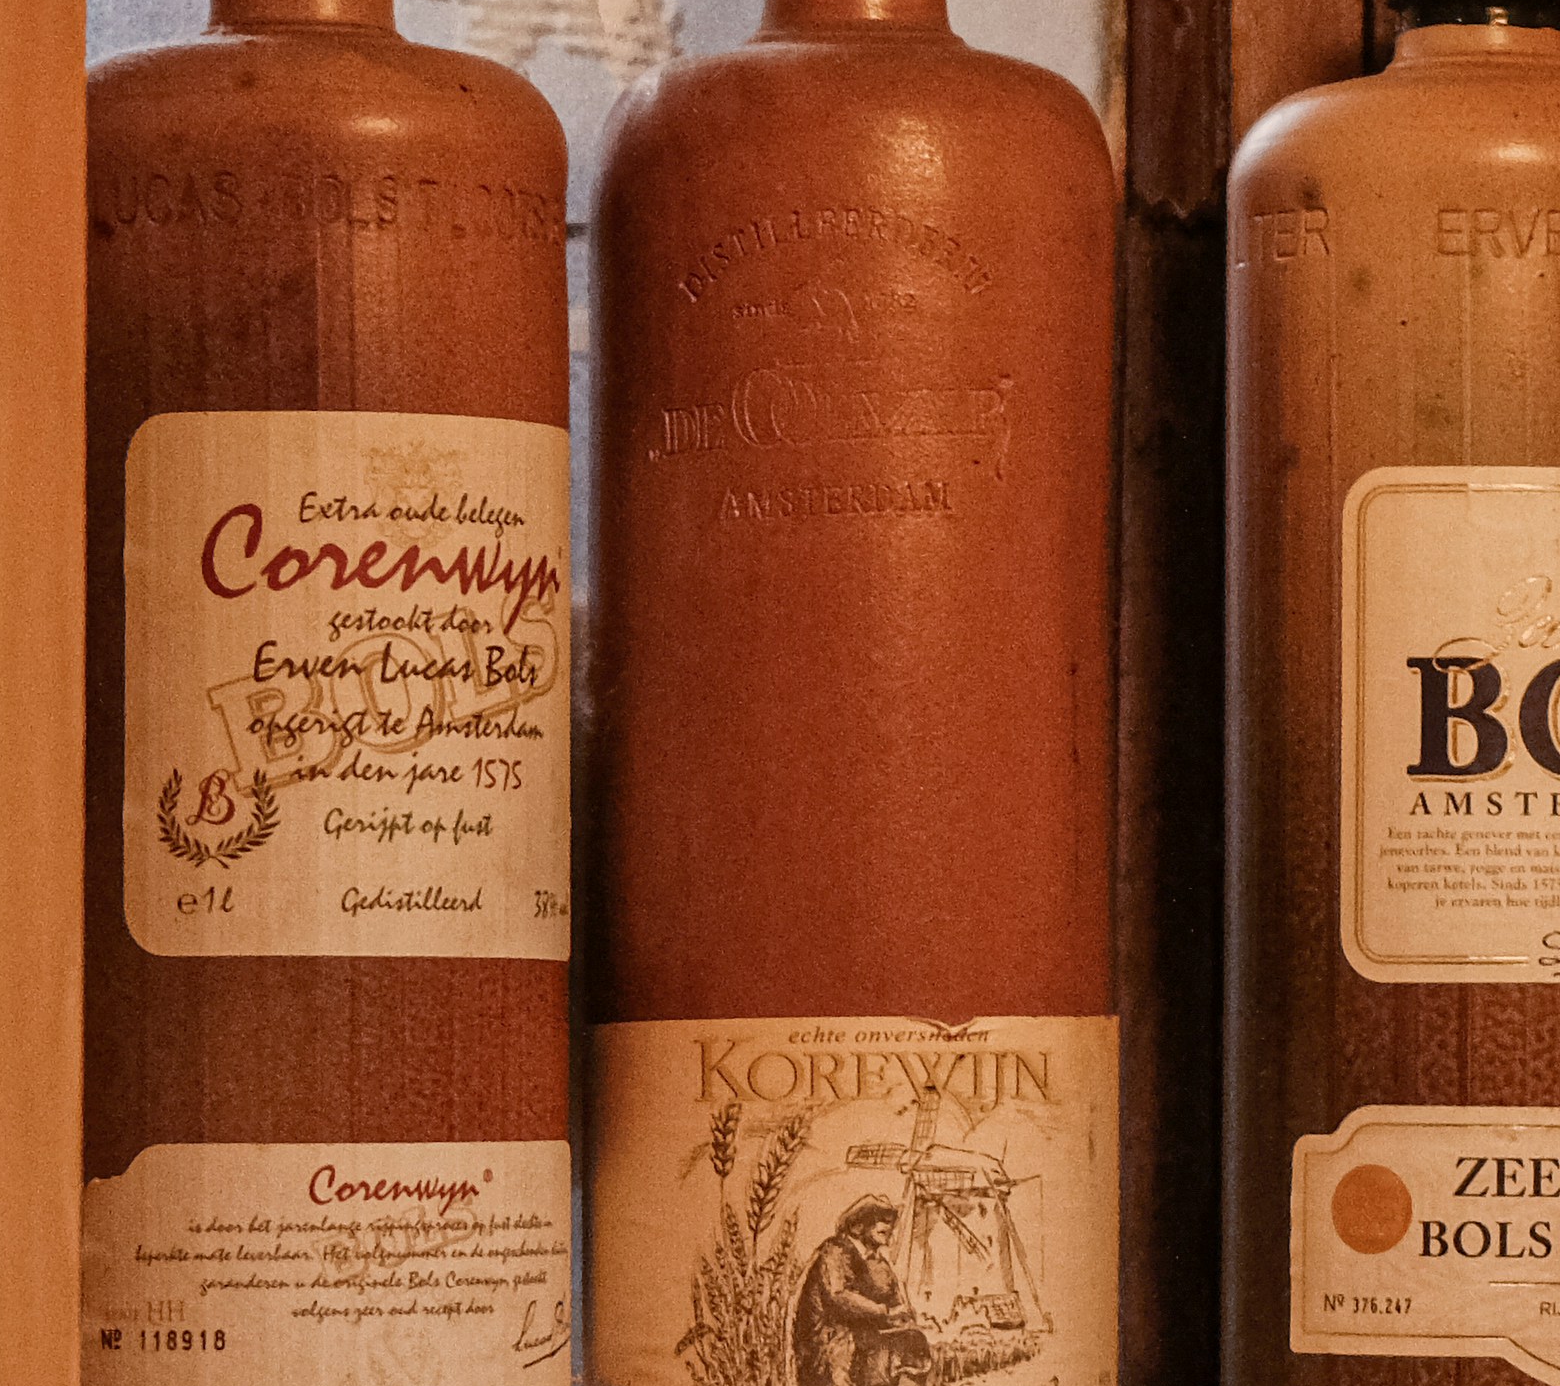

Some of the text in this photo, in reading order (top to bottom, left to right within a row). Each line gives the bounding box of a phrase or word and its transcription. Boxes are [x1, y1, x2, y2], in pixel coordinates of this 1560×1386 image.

[299, 491, 526, 539] Extra oude belegen
[441, 605, 494, 635] door
[252, 640, 539, 689] Erven Lucas Bols
[375, 710, 408, 738] te
[415, 707, 546, 741] Amsterdam
[339, 755, 399, 782] den
[403, 755, 464, 795] jare
[471, 756, 524, 791] 1575
[421, 812, 448, 839] op
[451, 809, 494, 845] fust
[340, 885, 483, 916] Gedistilleerd
[787, 1026, 848, 1045] echte
[692, 1037, 1063, 1114] KOREWIJN
[1417, 1219, 1553, 1260] BOLS
[407, 1270, 441, 1291] Bols
[139, 1327, 227, 1354] 118918
